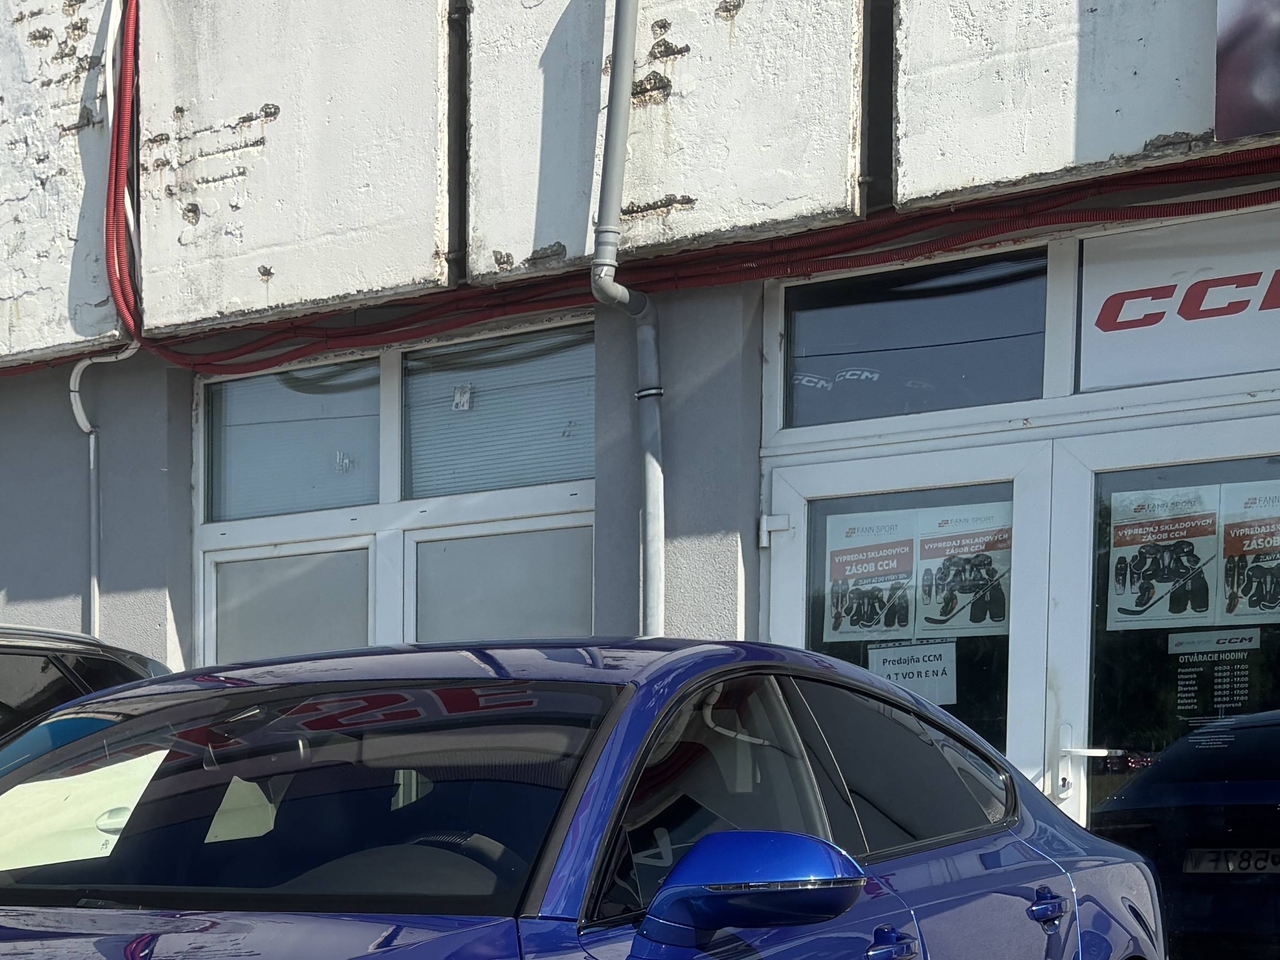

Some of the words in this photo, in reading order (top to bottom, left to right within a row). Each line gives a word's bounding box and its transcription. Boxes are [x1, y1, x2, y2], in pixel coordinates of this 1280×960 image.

[1094, 271, 1280, 333] CC
[1169, 530, 1187, 539] CCM
[834, 553, 867, 564] VÝPREDAJ
[867, 546, 910, 560] SKLADOVÝCH
[845, 560, 875, 576] ZÁSOB
[877, 559, 897, 571] CCM
[1216, 636, 1254, 645] CCM
[882, 655, 920, 667] Predajňa
[922, 653, 942, 663] CCM
[1178, 652, 1218, 663] OTVÁRACIE
[1219, 651, 1248, 660] HODINY
